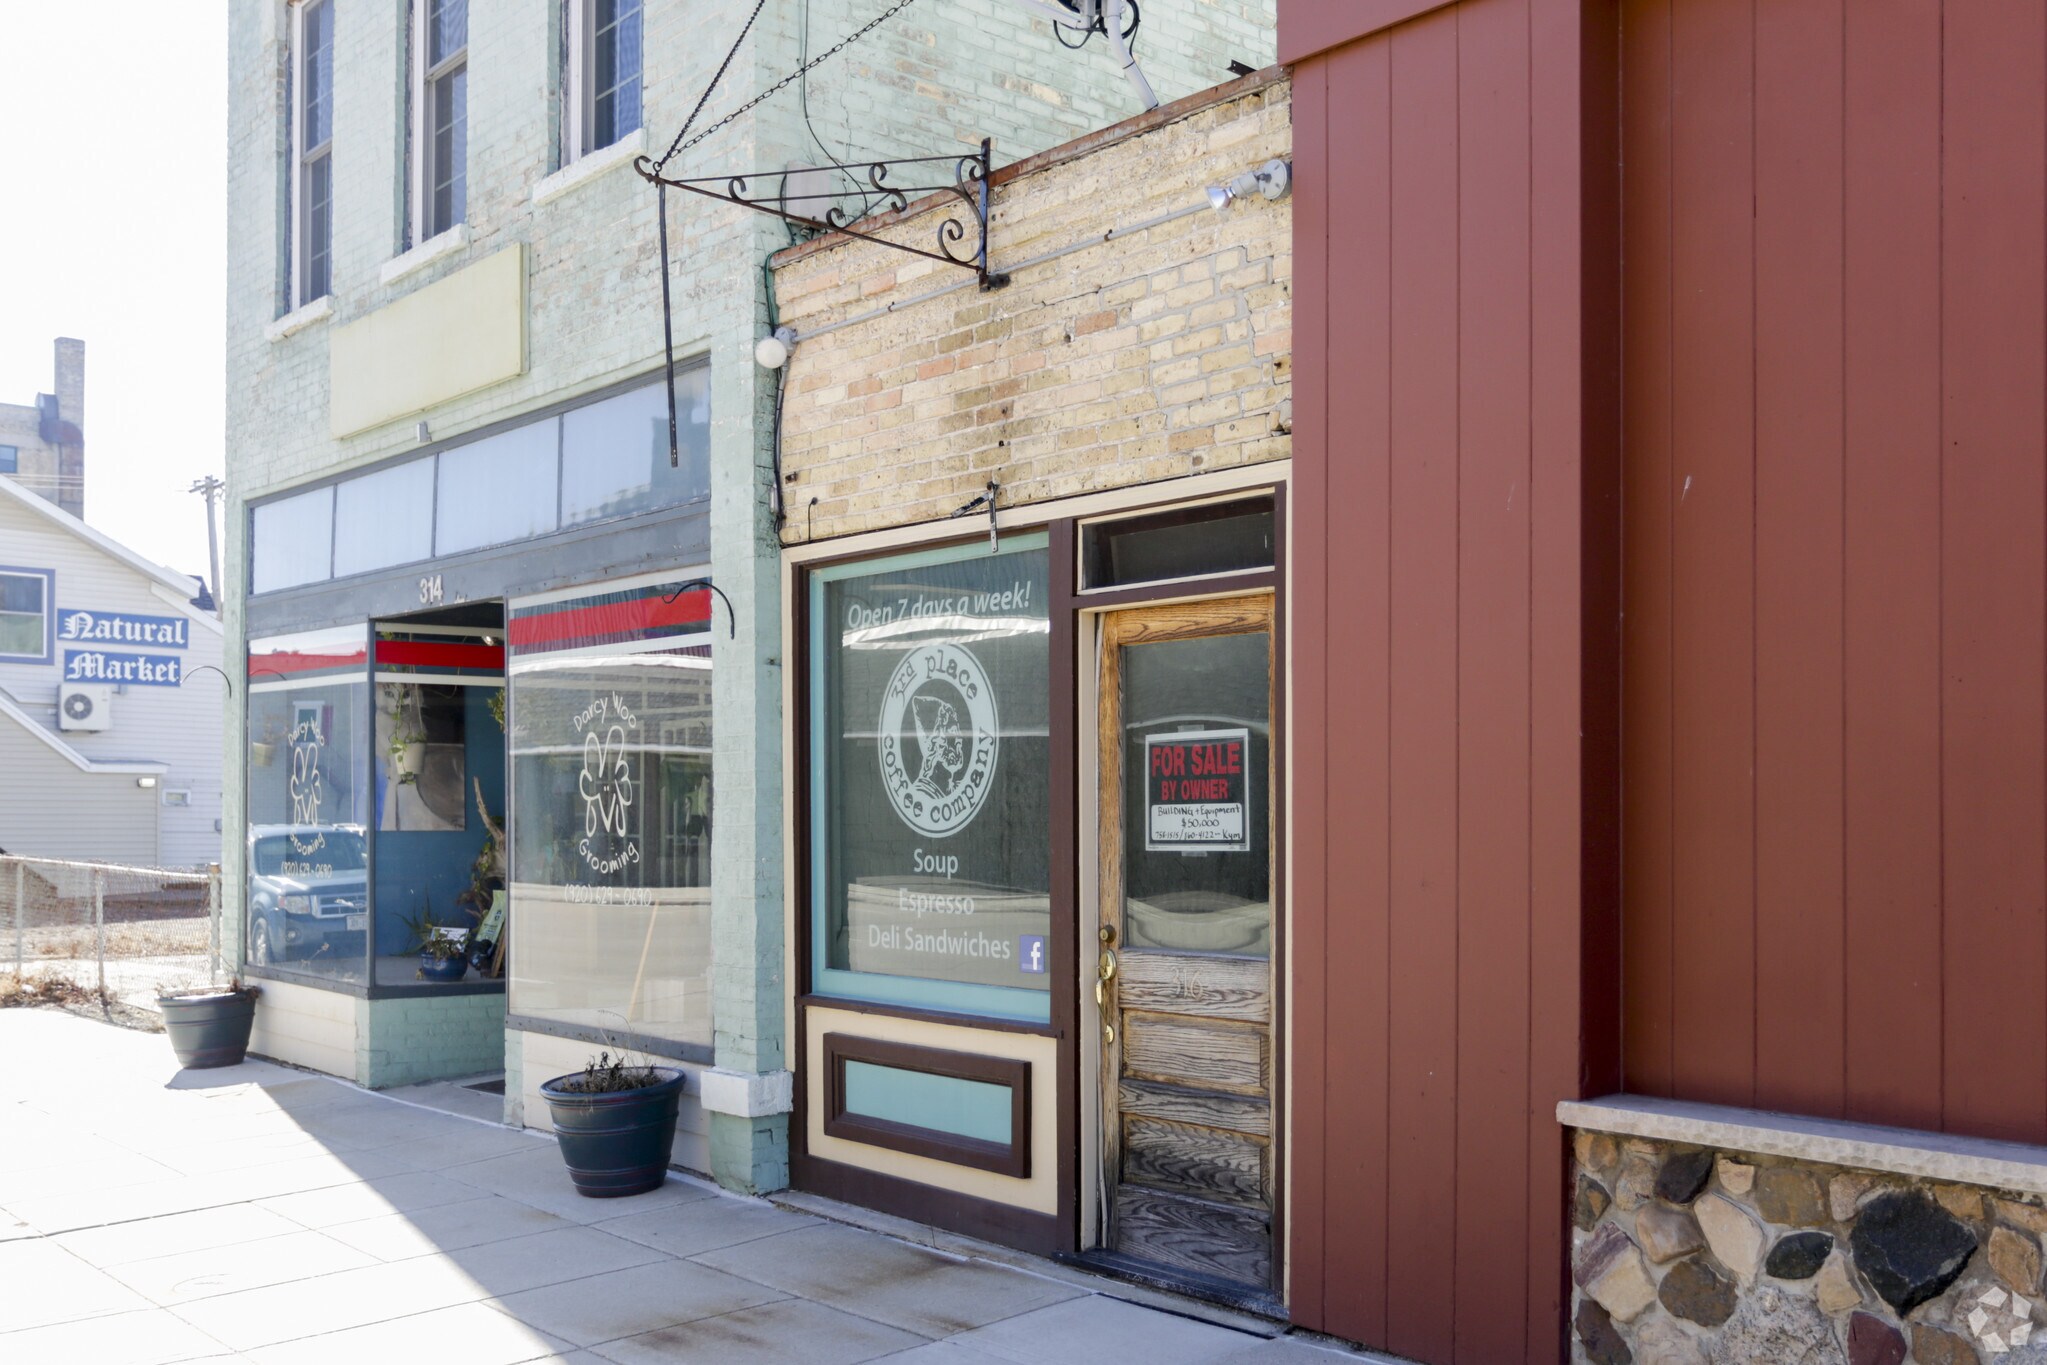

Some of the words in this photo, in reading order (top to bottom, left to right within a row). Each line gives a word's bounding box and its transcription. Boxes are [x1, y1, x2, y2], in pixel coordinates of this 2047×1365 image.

[420, 574, 443, 604] 314
[848, 604, 892, 629] Open
[898, 599, 908, 622] 7
[910, 594, 952, 619] days
[957, 595, 969, 616] a
[974, 581, 1032, 613] week!
[58, 612, 186, 644] Natural
[66, 652, 180, 683] Market
[890, 660, 918, 706] 3rd
[925, 649, 978, 701] place
[573, 697, 609, 733] Darcy
[612, 690, 637, 728] Woo
[288, 721, 309, 747] Darcy
[883, 732, 923, 818] coffee
[929, 726, 995, 823] company
[1151, 744, 1186, 777] FOR
[1191, 742, 1242, 776] SALE
[1161, 780, 1177, 801] BY
[1181, 778, 1228, 800] OWNER
[1181, 817, 1220, 828] $50,000
[1222, 829, 1241, 840] Kym
[579, 838, 640, 874] Grooming
[913, 848, 959, 879] Soup
[564, 883, 593, 904] (920)
[899, 887, 975, 918] Espresso
[869, 924, 900, 948] Deli
[904, 927, 1011, 960] Sandwiches
